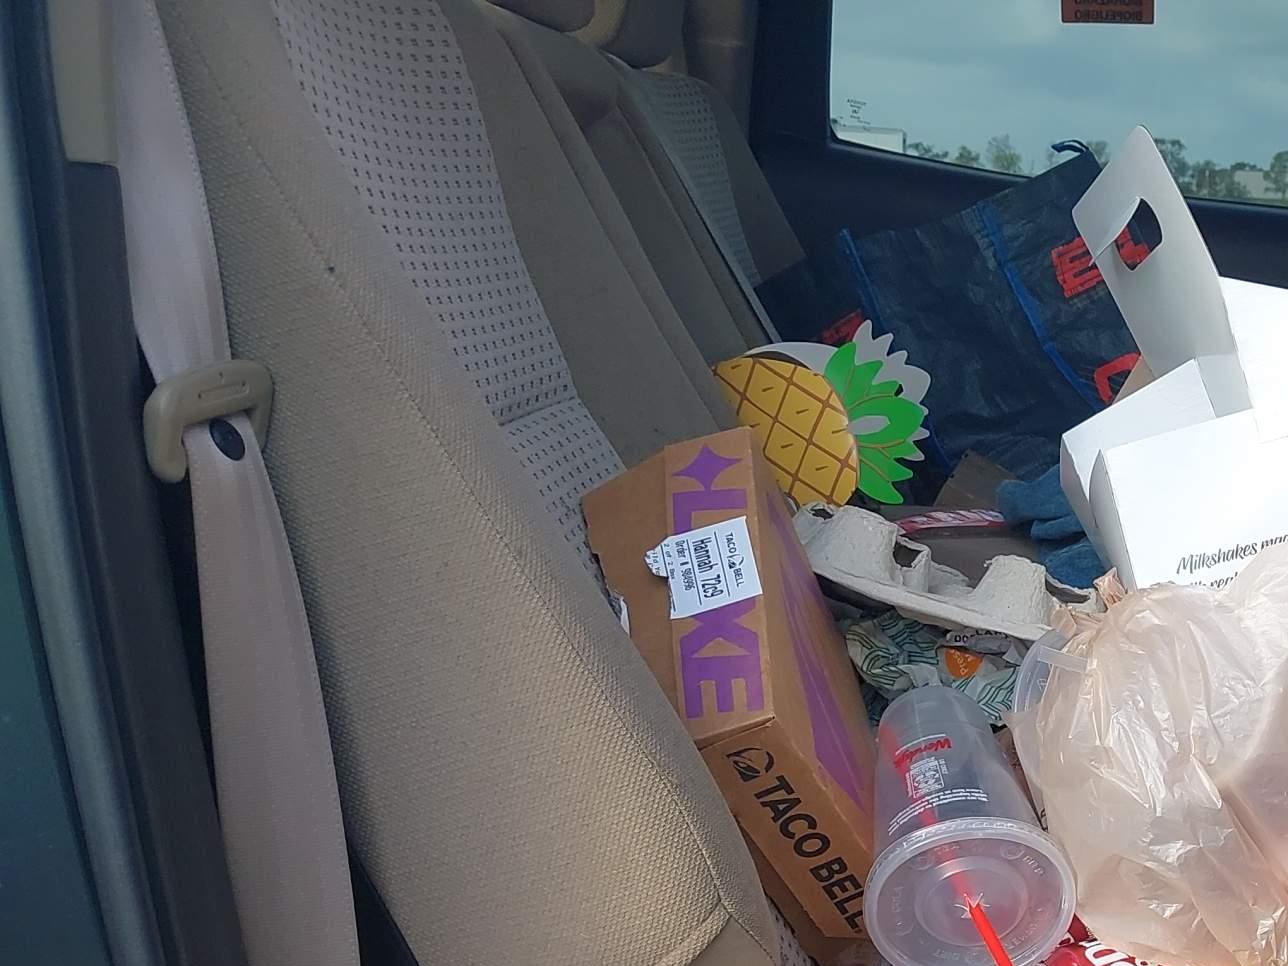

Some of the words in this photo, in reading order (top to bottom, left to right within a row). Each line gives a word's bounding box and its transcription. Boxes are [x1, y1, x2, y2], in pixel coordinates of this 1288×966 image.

[676, 540, 686, 558] Order
[692, 537, 718, 574] Hannah
[725, 532, 736, 554] TACO
[734, 568, 744, 588] BELL
[1176, 542, 1258, 574] Milkshakes
[672, 490, 764, 719] LXE
[701, 574, 724, 598] 72c9
[754, 775, 830, 858] TACO
